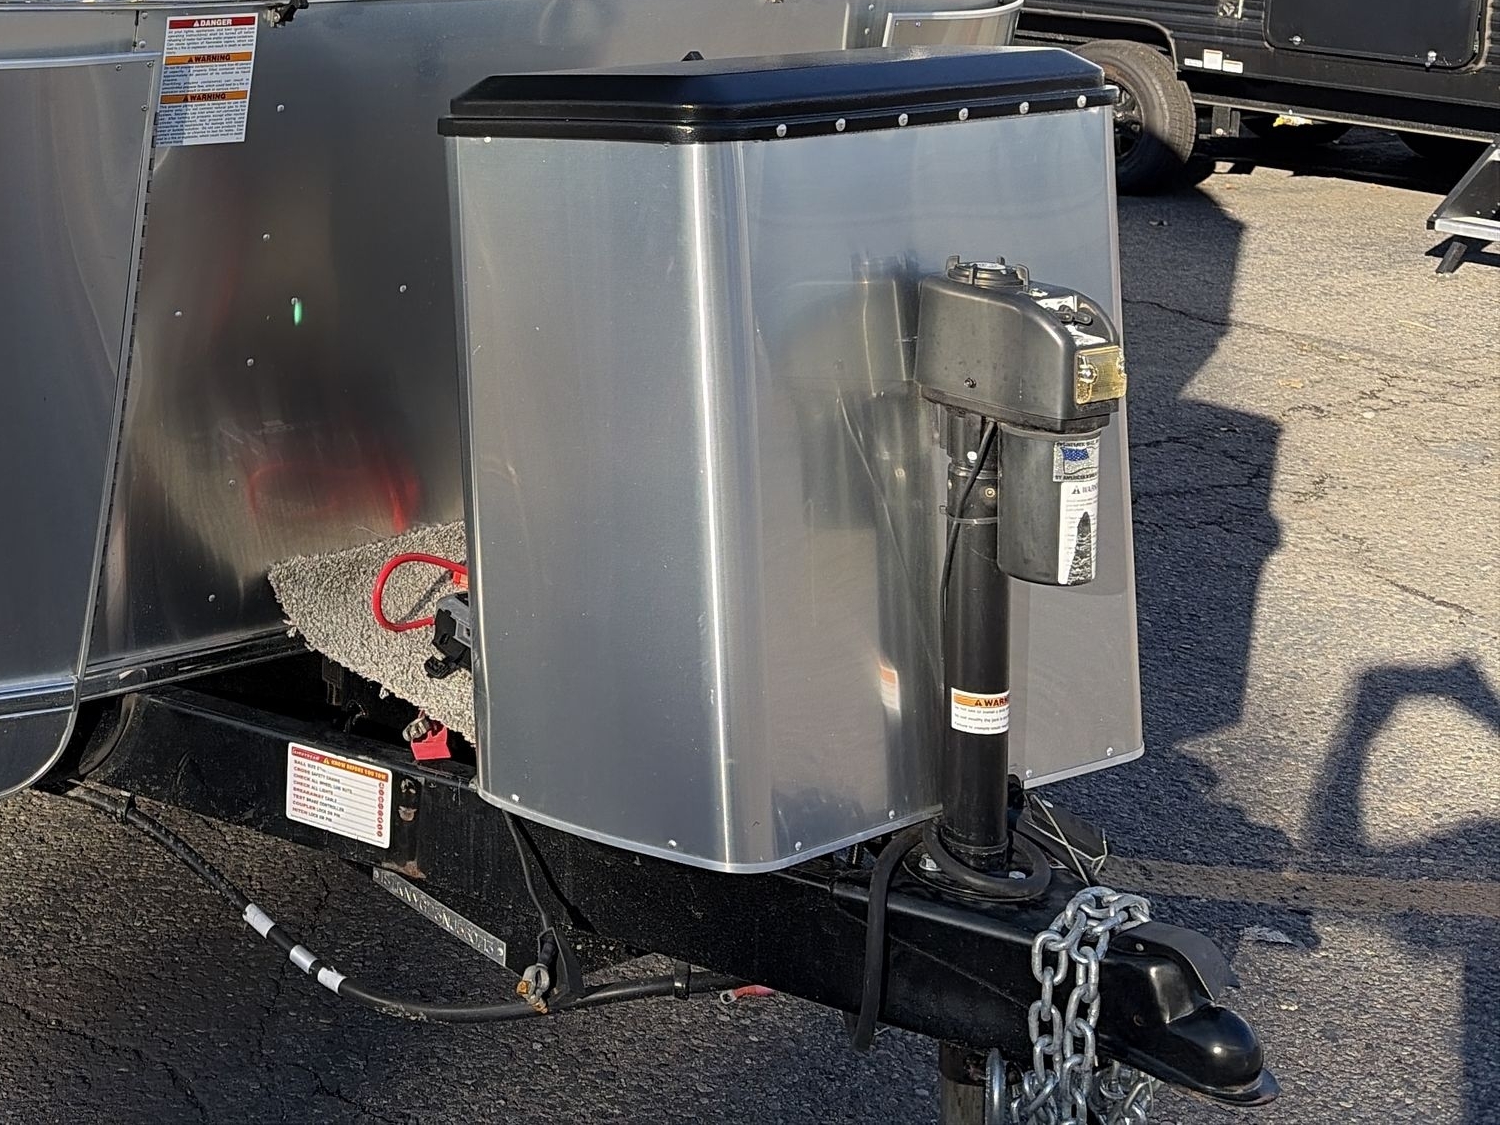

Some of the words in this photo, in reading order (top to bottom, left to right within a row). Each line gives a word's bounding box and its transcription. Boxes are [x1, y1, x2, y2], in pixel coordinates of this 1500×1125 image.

[200, 18, 233, 27] DANGER
[194, 54, 231, 63] WARNING
[190, 92, 227, 102] WARNING
